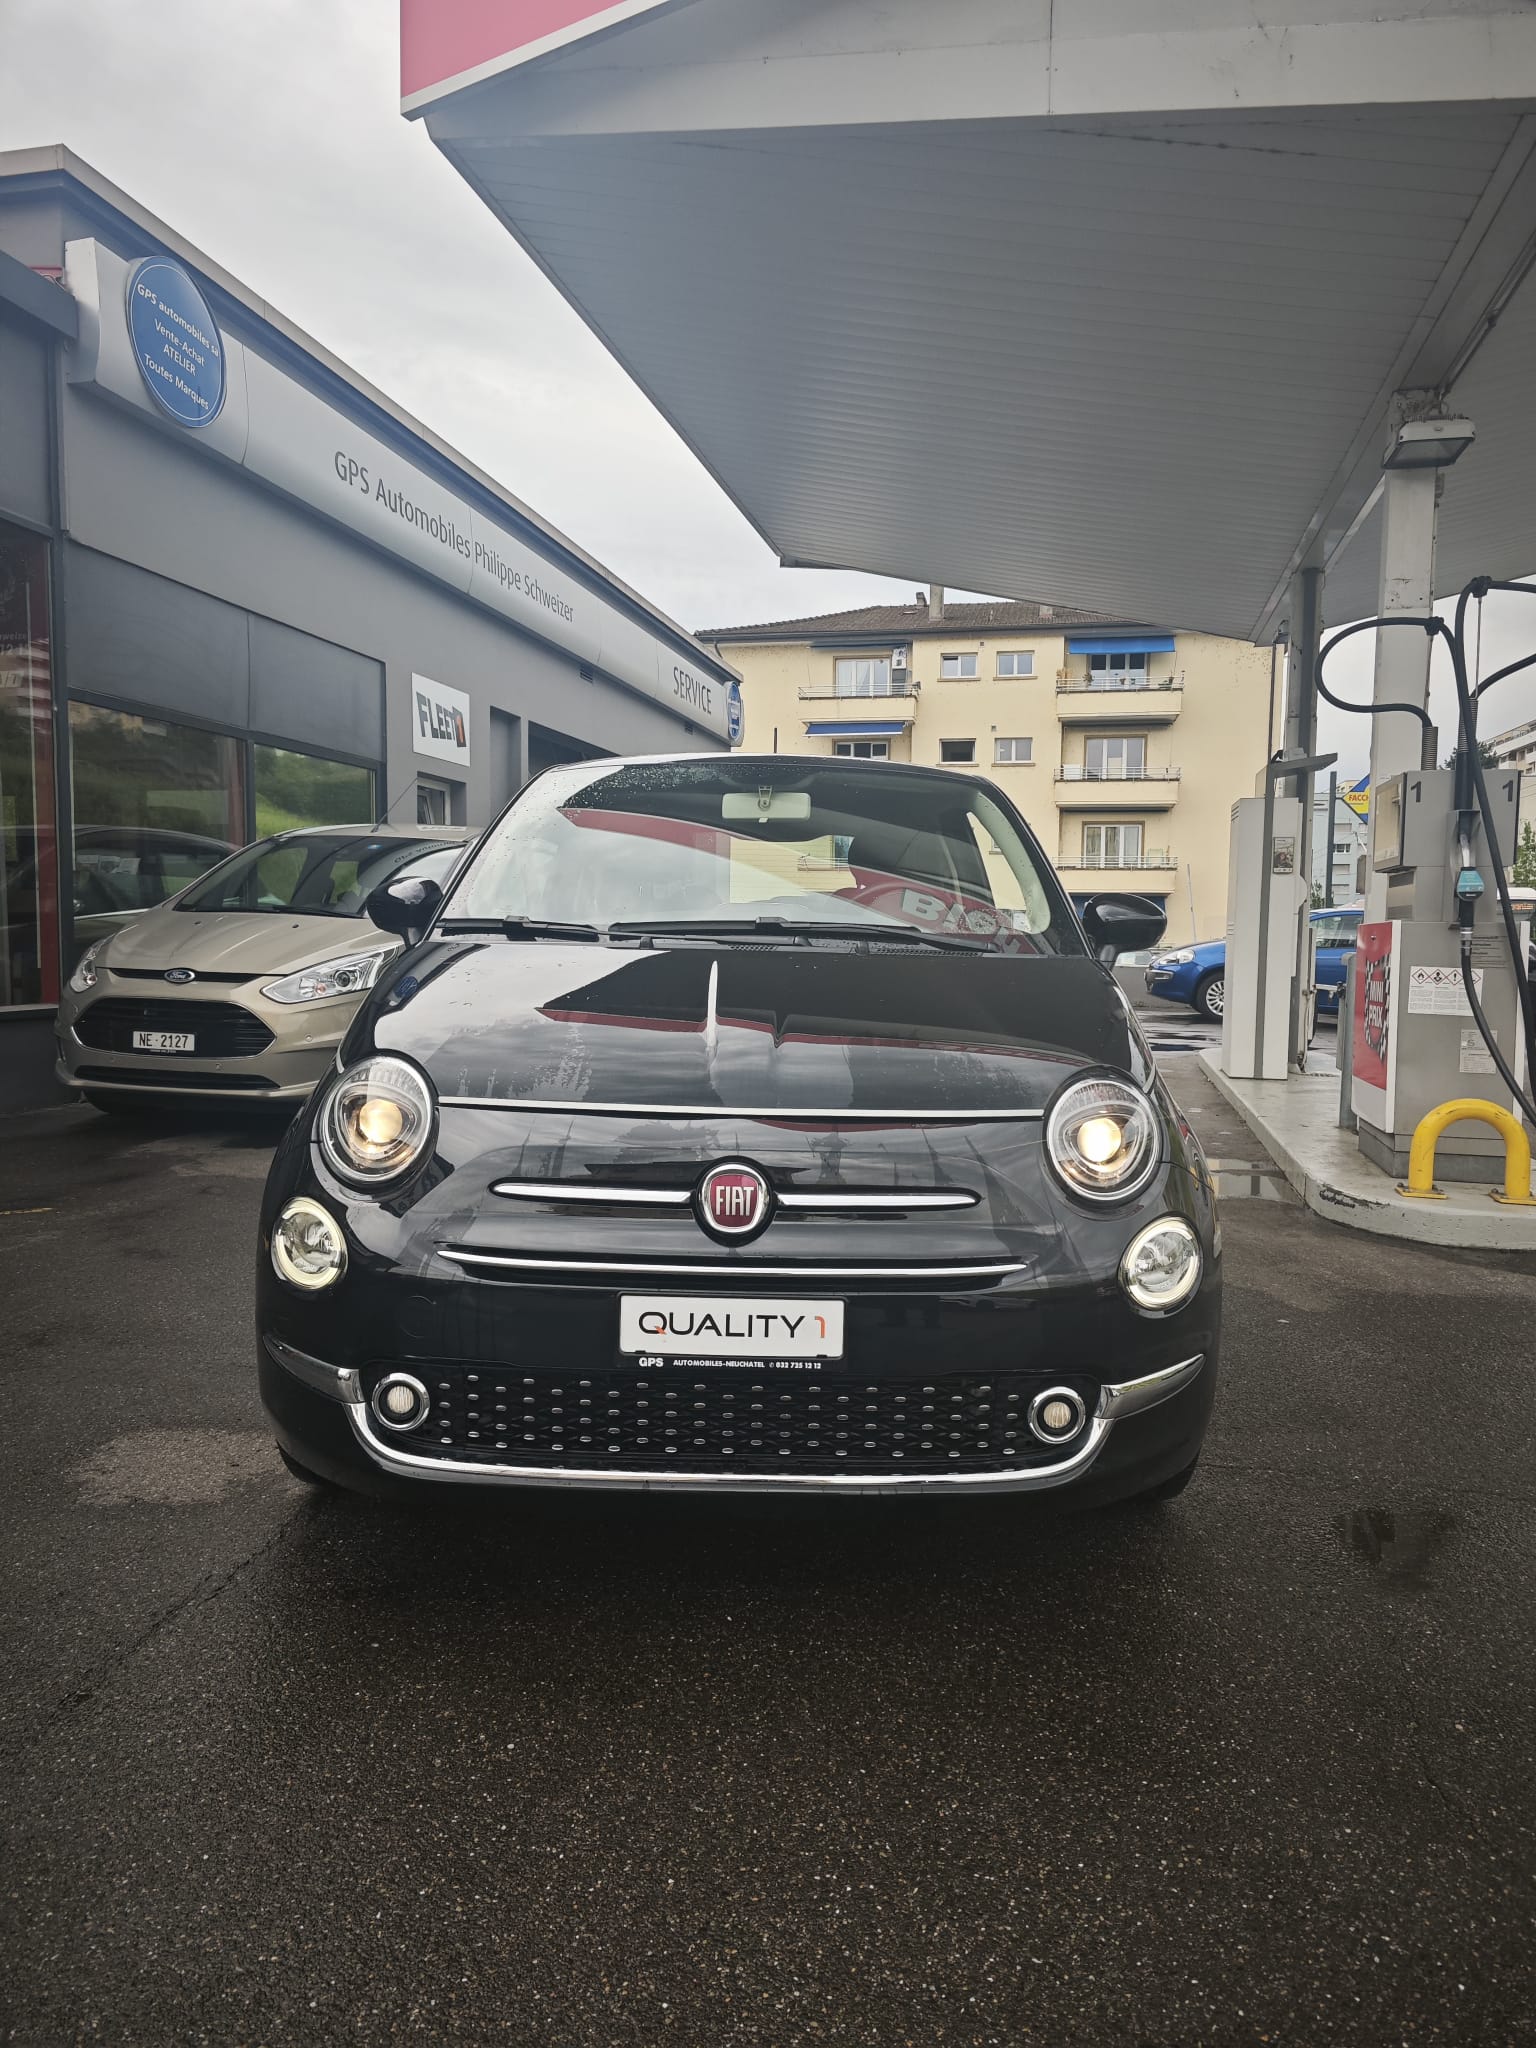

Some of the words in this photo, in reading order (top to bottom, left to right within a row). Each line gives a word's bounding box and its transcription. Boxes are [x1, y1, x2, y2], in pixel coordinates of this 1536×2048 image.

[137, 283, 157, 305] GPS
[159, 301, 210, 349] automobiles
[155, 318, 205, 367] Vente-Achat
[163, 344, 196, 376] ATELIER
[144, 353, 173, 383] Toutes
[175, 375, 209, 410] Marques
[335, 451, 370, 494] GPS
[375, 478, 471, 558] Automobiles
[474, 541, 521, 591] Philippe
[524, 575, 574, 623] Schweizer
[673, 666, 712, 715] SERVICE
[1411, 781, 1422, 803] 1
[1502, 780, 1514, 802] 1
[1368, 1004, 1383, 1028] PRIX
[139, 1033, 153, 1047] NE
[160, 1034, 189, 1049] 2127
[715, 1185, 755, 1217] FIAT
[638, 1311, 806, 1339] QUALITY
[638, 1357, 664, 1368] GPS
[673, 1358, 766, 1369] AUTOMOBILES-NEUCHATEL
[775, 1361, 789, 1369] 032
